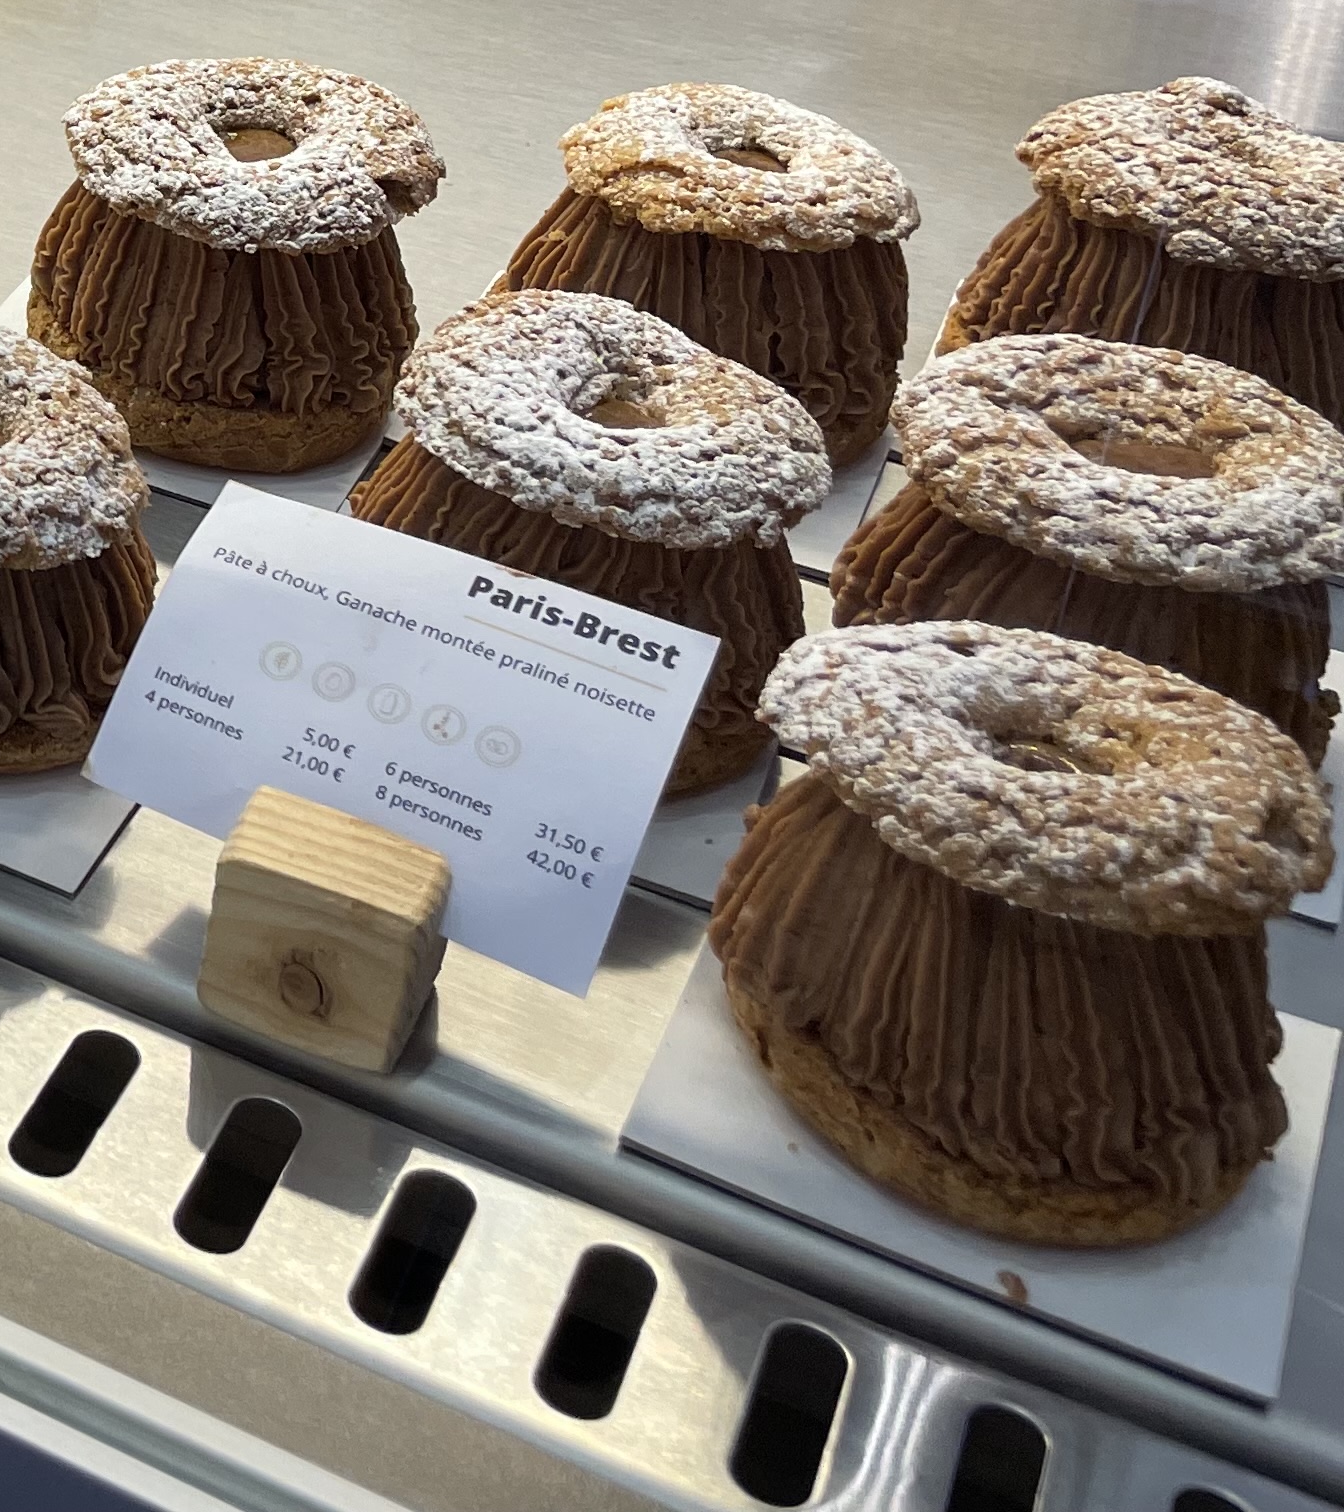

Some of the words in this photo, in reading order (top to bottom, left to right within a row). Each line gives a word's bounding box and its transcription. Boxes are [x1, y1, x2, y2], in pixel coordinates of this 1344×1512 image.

[213, 547, 253, 570] Pâte
[256, 561, 268, 575] à
[272, 569, 329, 601] choux,
[336, 590, 417, 632] Ganache
[421, 624, 496, 661] montée
[498, 654, 569, 689] praliné
[574, 681, 656, 722] noisette
[467, 575, 681, 670] Paris-Brest
[144, 690, 156, 703] 4
[157, 697, 244, 741] personnes
[282, 746, 329, 776] 21,00
[333, 767, 346, 783] €
[375, 785, 388, 800] 8
[389, 794, 483, 842] personnes
[527, 850, 577, 880] 42,00
[582, 872, 595, 889] €
[154, 666, 234, 709] Individuel
[302, 727, 340, 752] 5,00
[344, 744, 356, 759] €
[385, 761, 398, 776] 6
[398, 769, 492, 816] personnes
[534, 823, 586, 854] 31,50
[591, 846, 605, 863] €
